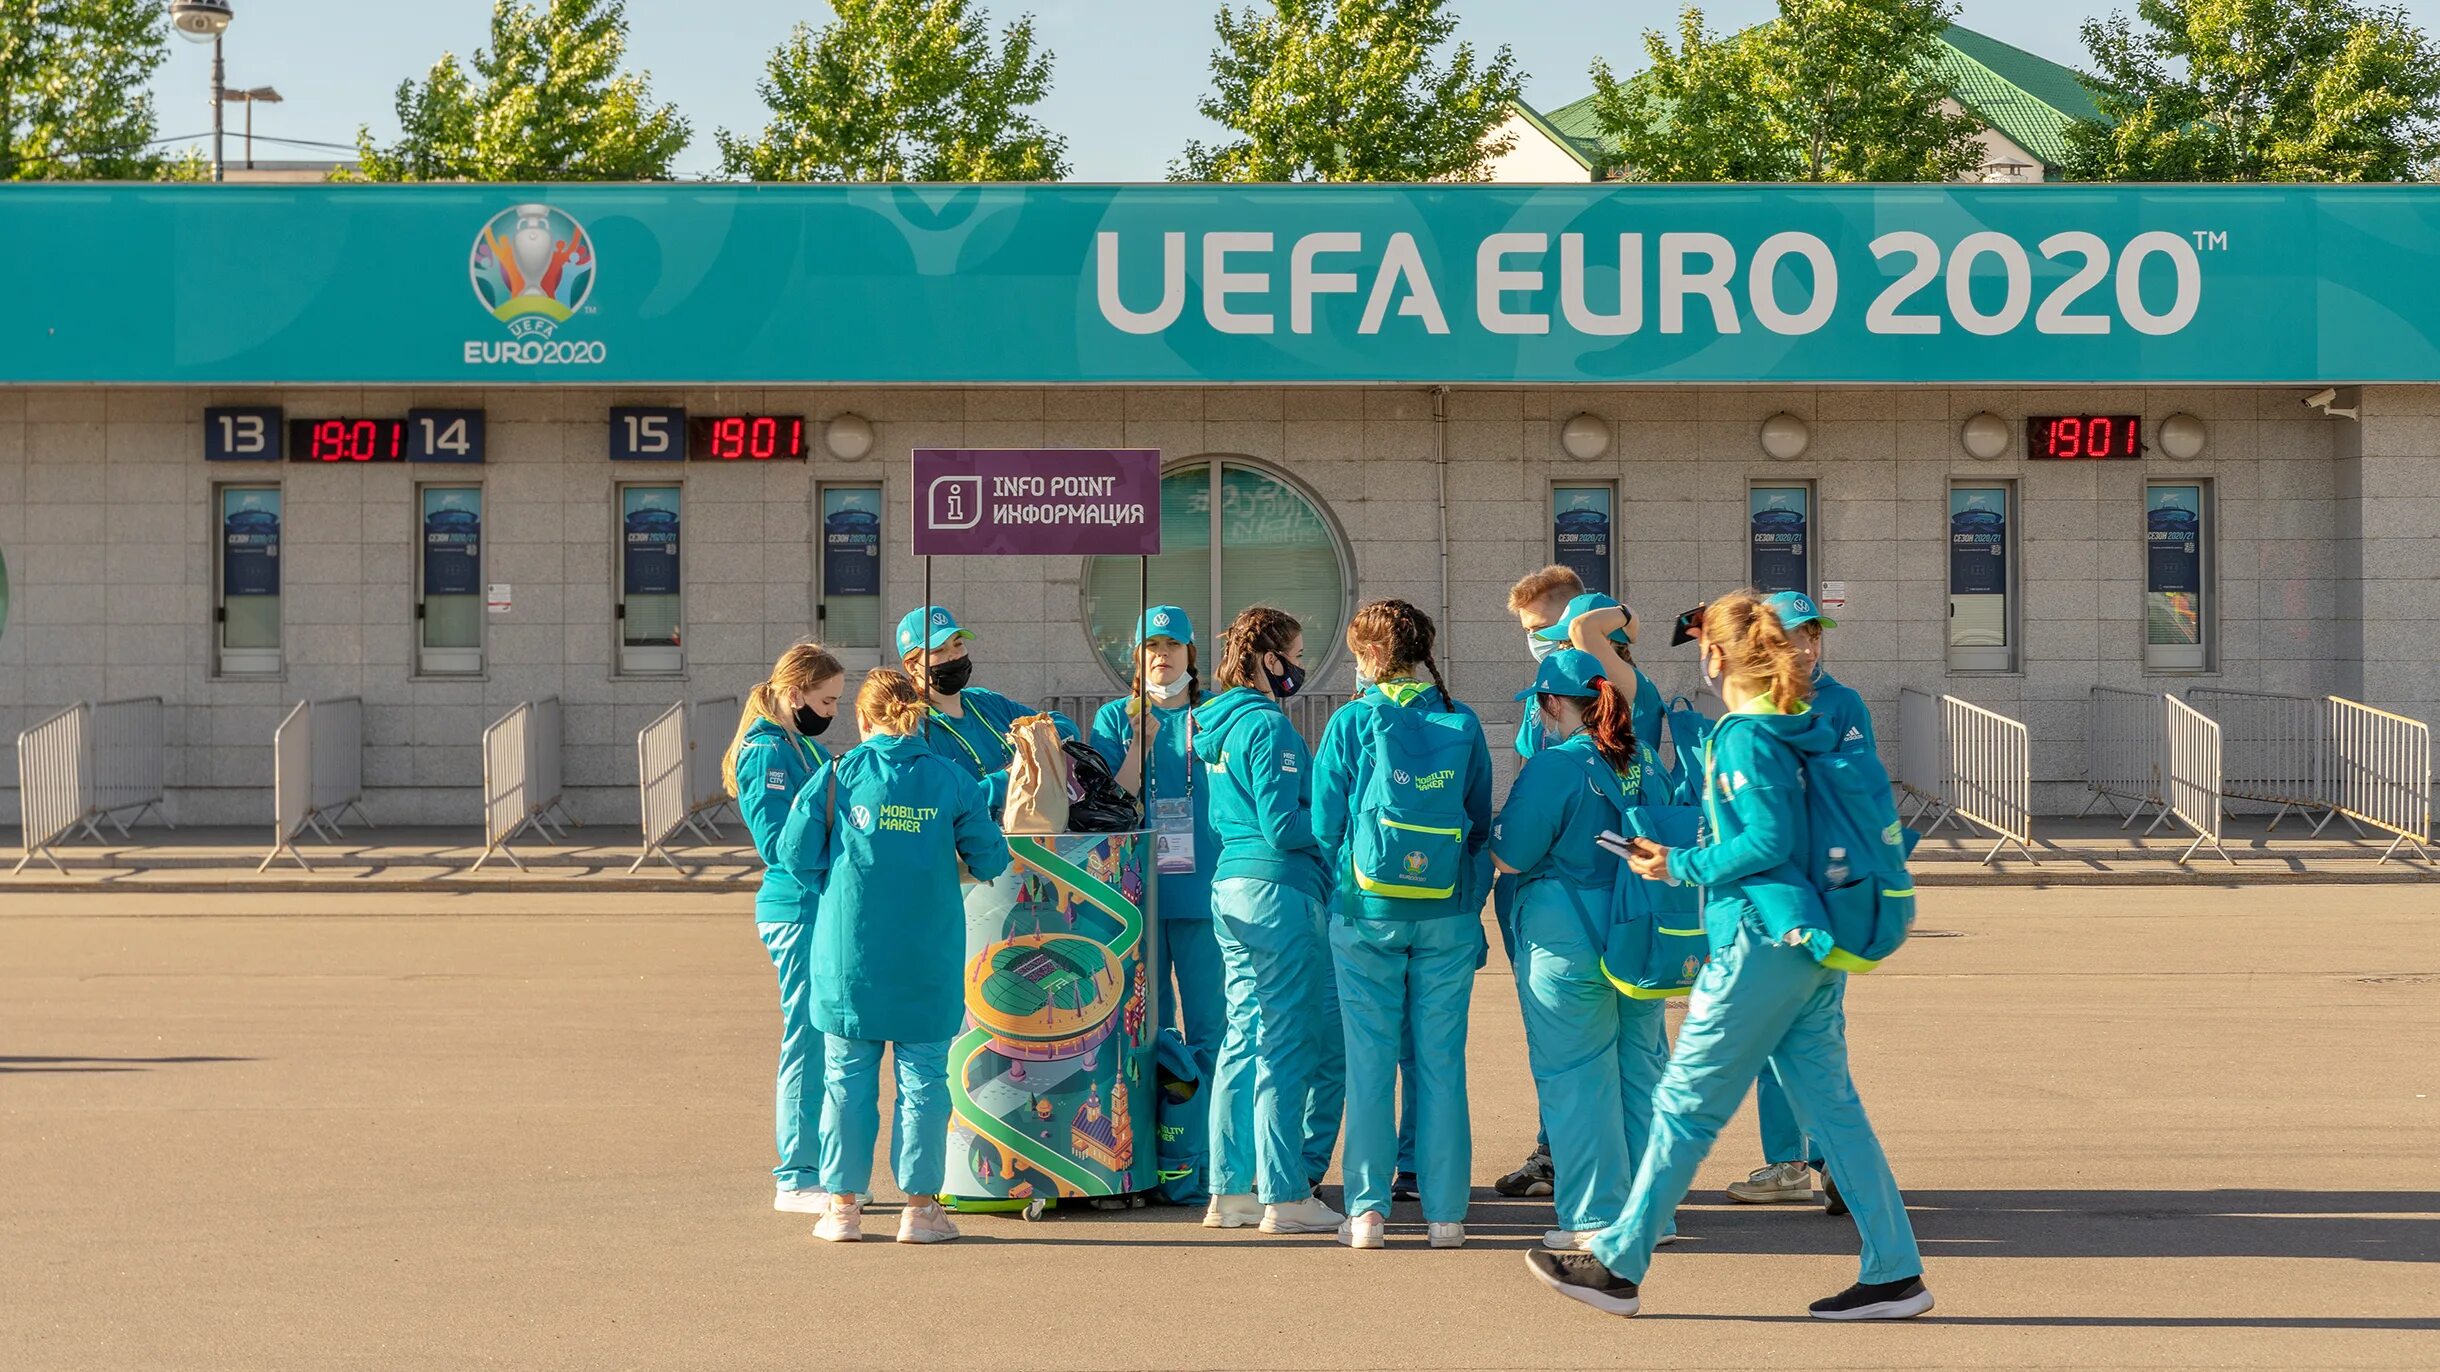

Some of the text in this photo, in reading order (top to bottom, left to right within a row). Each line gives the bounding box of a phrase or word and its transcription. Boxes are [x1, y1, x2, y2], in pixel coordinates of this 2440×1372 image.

[1097, 232, 1450, 334] UEFA
[1477, 232, 1838, 336] EURO
[1866, 231, 2200, 336] 2020
[510, 319, 553, 337] UEFA
[219, 416, 265, 452] 13
[312, 421, 400, 461] 19:01
[420, 418, 470, 455] 14
[624, 416, 669, 452] 15
[993, 476, 1116, 497] INFO POINT
[993, 504, 1145, 527] ИНФОРМАЦИЯ
[1558, 533, 1606, 543] СЕЗОН 2020/21
[1754, 533, 1802, 543] СЕЗОН 2020/21
[1953, 534, 2001, 543] СЕЗОН 2020/21
[2147, 532, 2194, 541] СЕЗОН 2020/21
[769, 770, 784, 778] HOST
[769, 776, 784, 784] CITY
[1415, 770, 1455, 785] MOBILITY
[1415, 780, 1444, 791] MAKER
[880, 804, 938, 820] MOBILITY
[879, 818, 921, 833] MAKER
